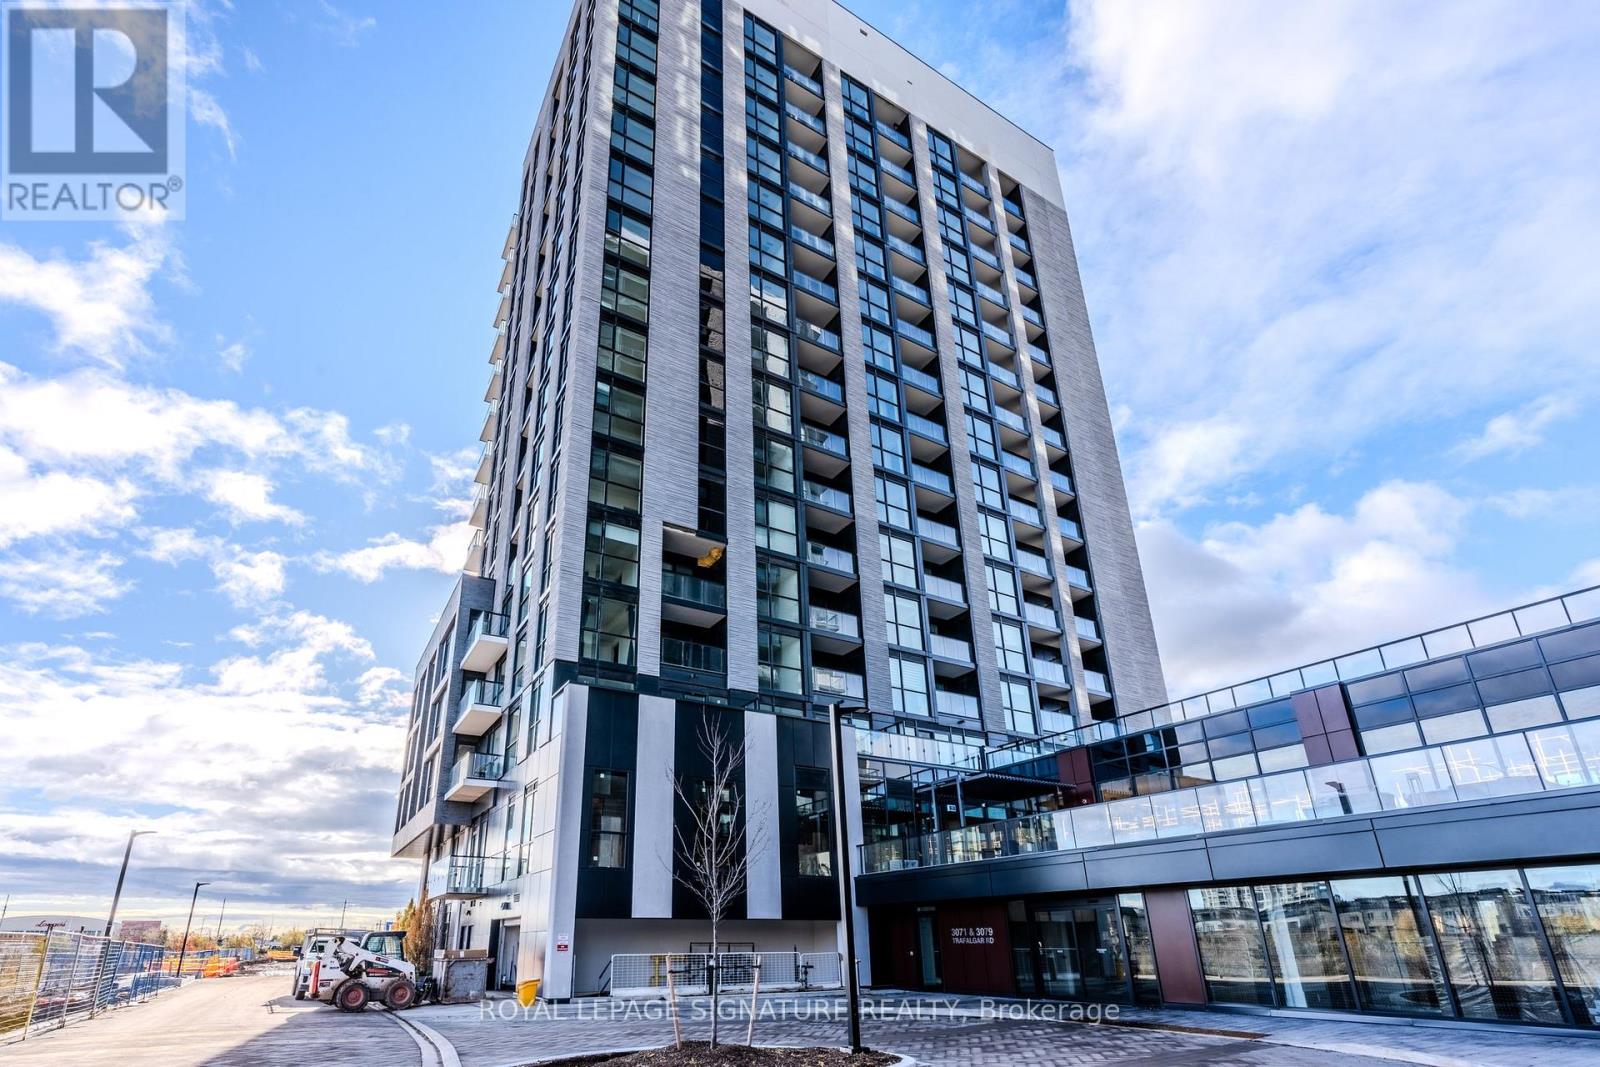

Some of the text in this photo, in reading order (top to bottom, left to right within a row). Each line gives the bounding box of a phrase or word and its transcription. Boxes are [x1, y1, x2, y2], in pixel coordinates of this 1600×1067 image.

[951, 927, 993, 936] 3071 & 3079
